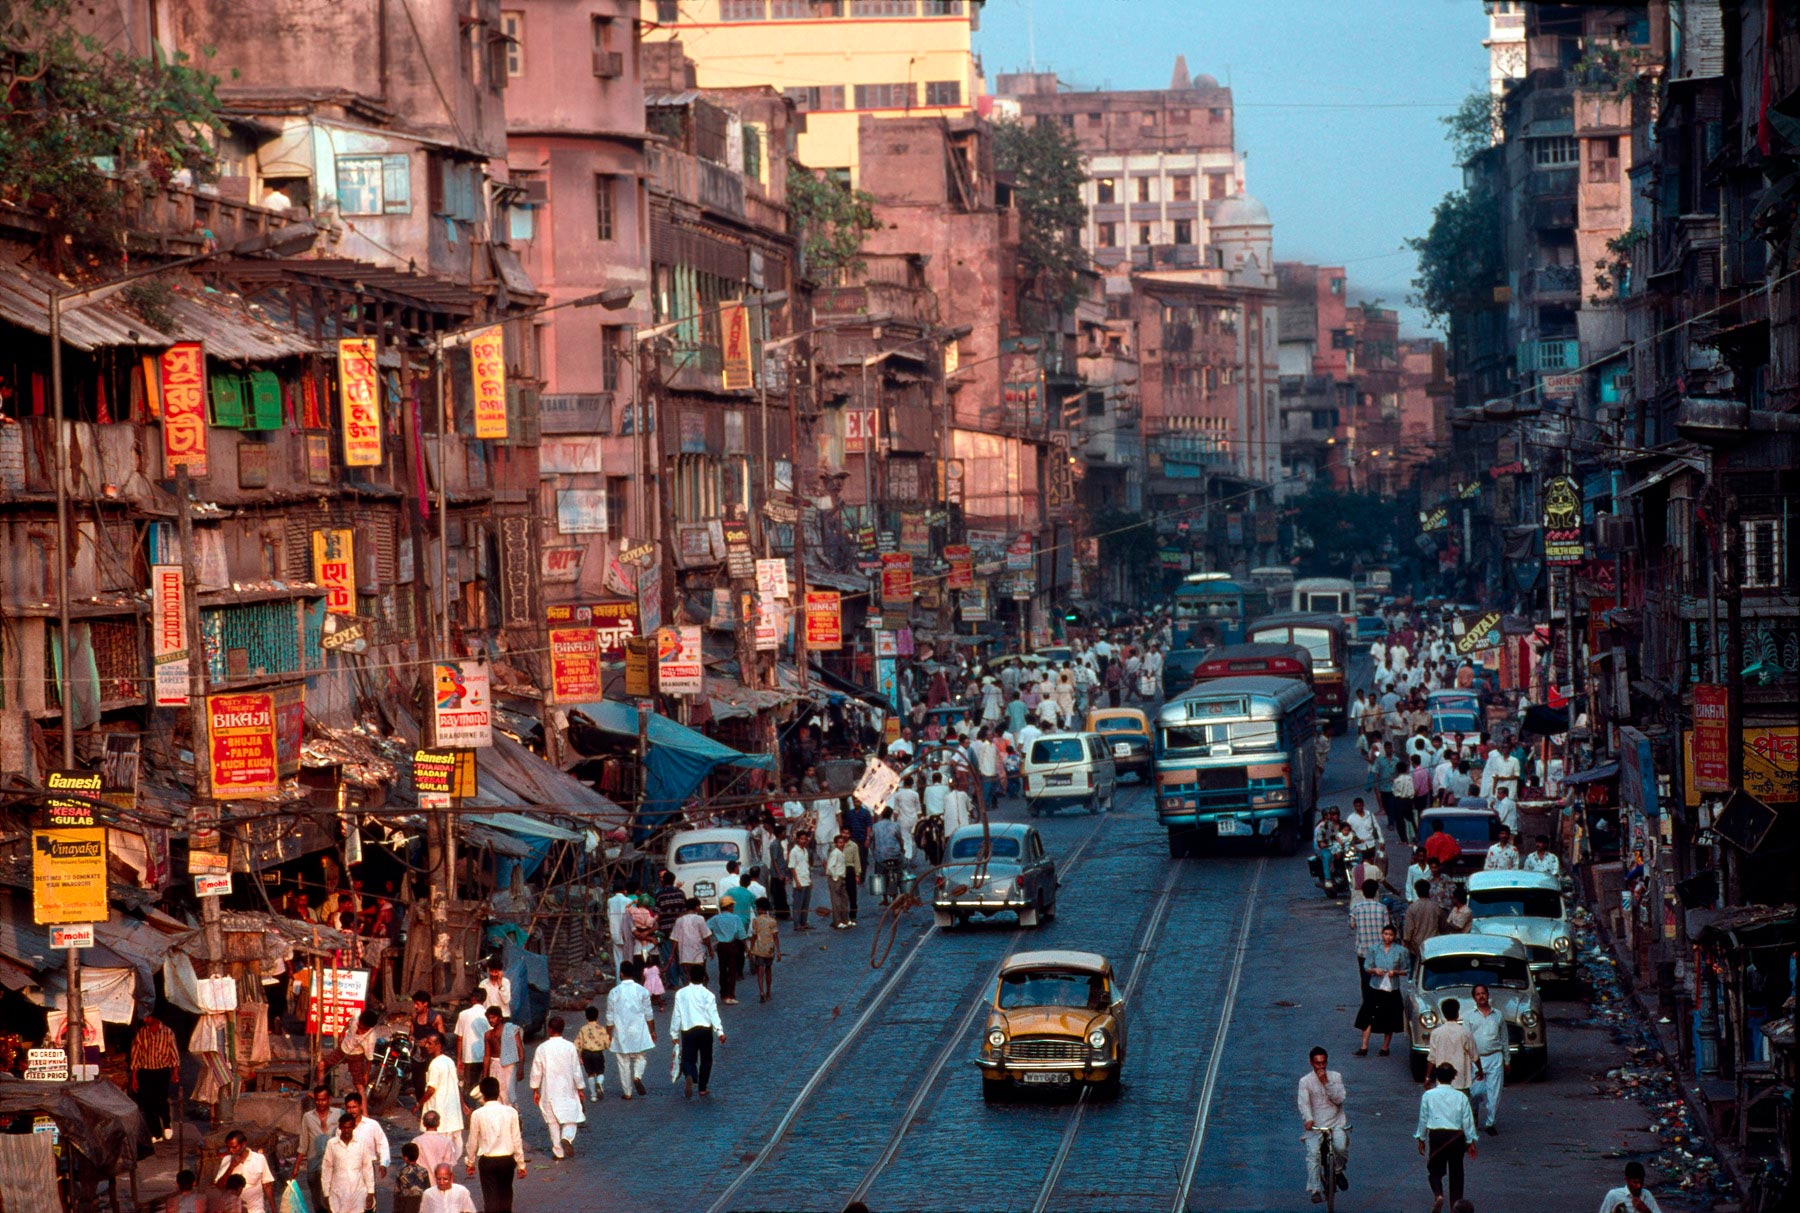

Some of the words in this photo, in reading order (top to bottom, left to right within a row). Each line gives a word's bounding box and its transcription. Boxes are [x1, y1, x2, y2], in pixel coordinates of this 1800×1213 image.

[618, 543, 654, 564] GOYAL
[1458, 612, 1501, 652] GOYAL
[213, 711, 270, 728] BIKAJI
[227, 736, 262, 747] BHUJIA
[230, 747, 261, 758] PAPAD
[414, 750, 455, 764] Ganesh
[220, 759, 245, 769] KUCH
[247, 758, 272, 768] KUCH
[417, 763, 454, 772] THANDAI
[417, 770, 448, 778] BADAM
[48, 772, 102, 789] Ganesh
[420, 782, 449, 791] GULAB
[53, 807, 91, 816] KESAR
[55, 816, 94, 825] GULAB
[52, 841, 99, 857] Vinayaka
[206, 880, 228, 888] mohit
[64, 931, 90, 940] mohit
